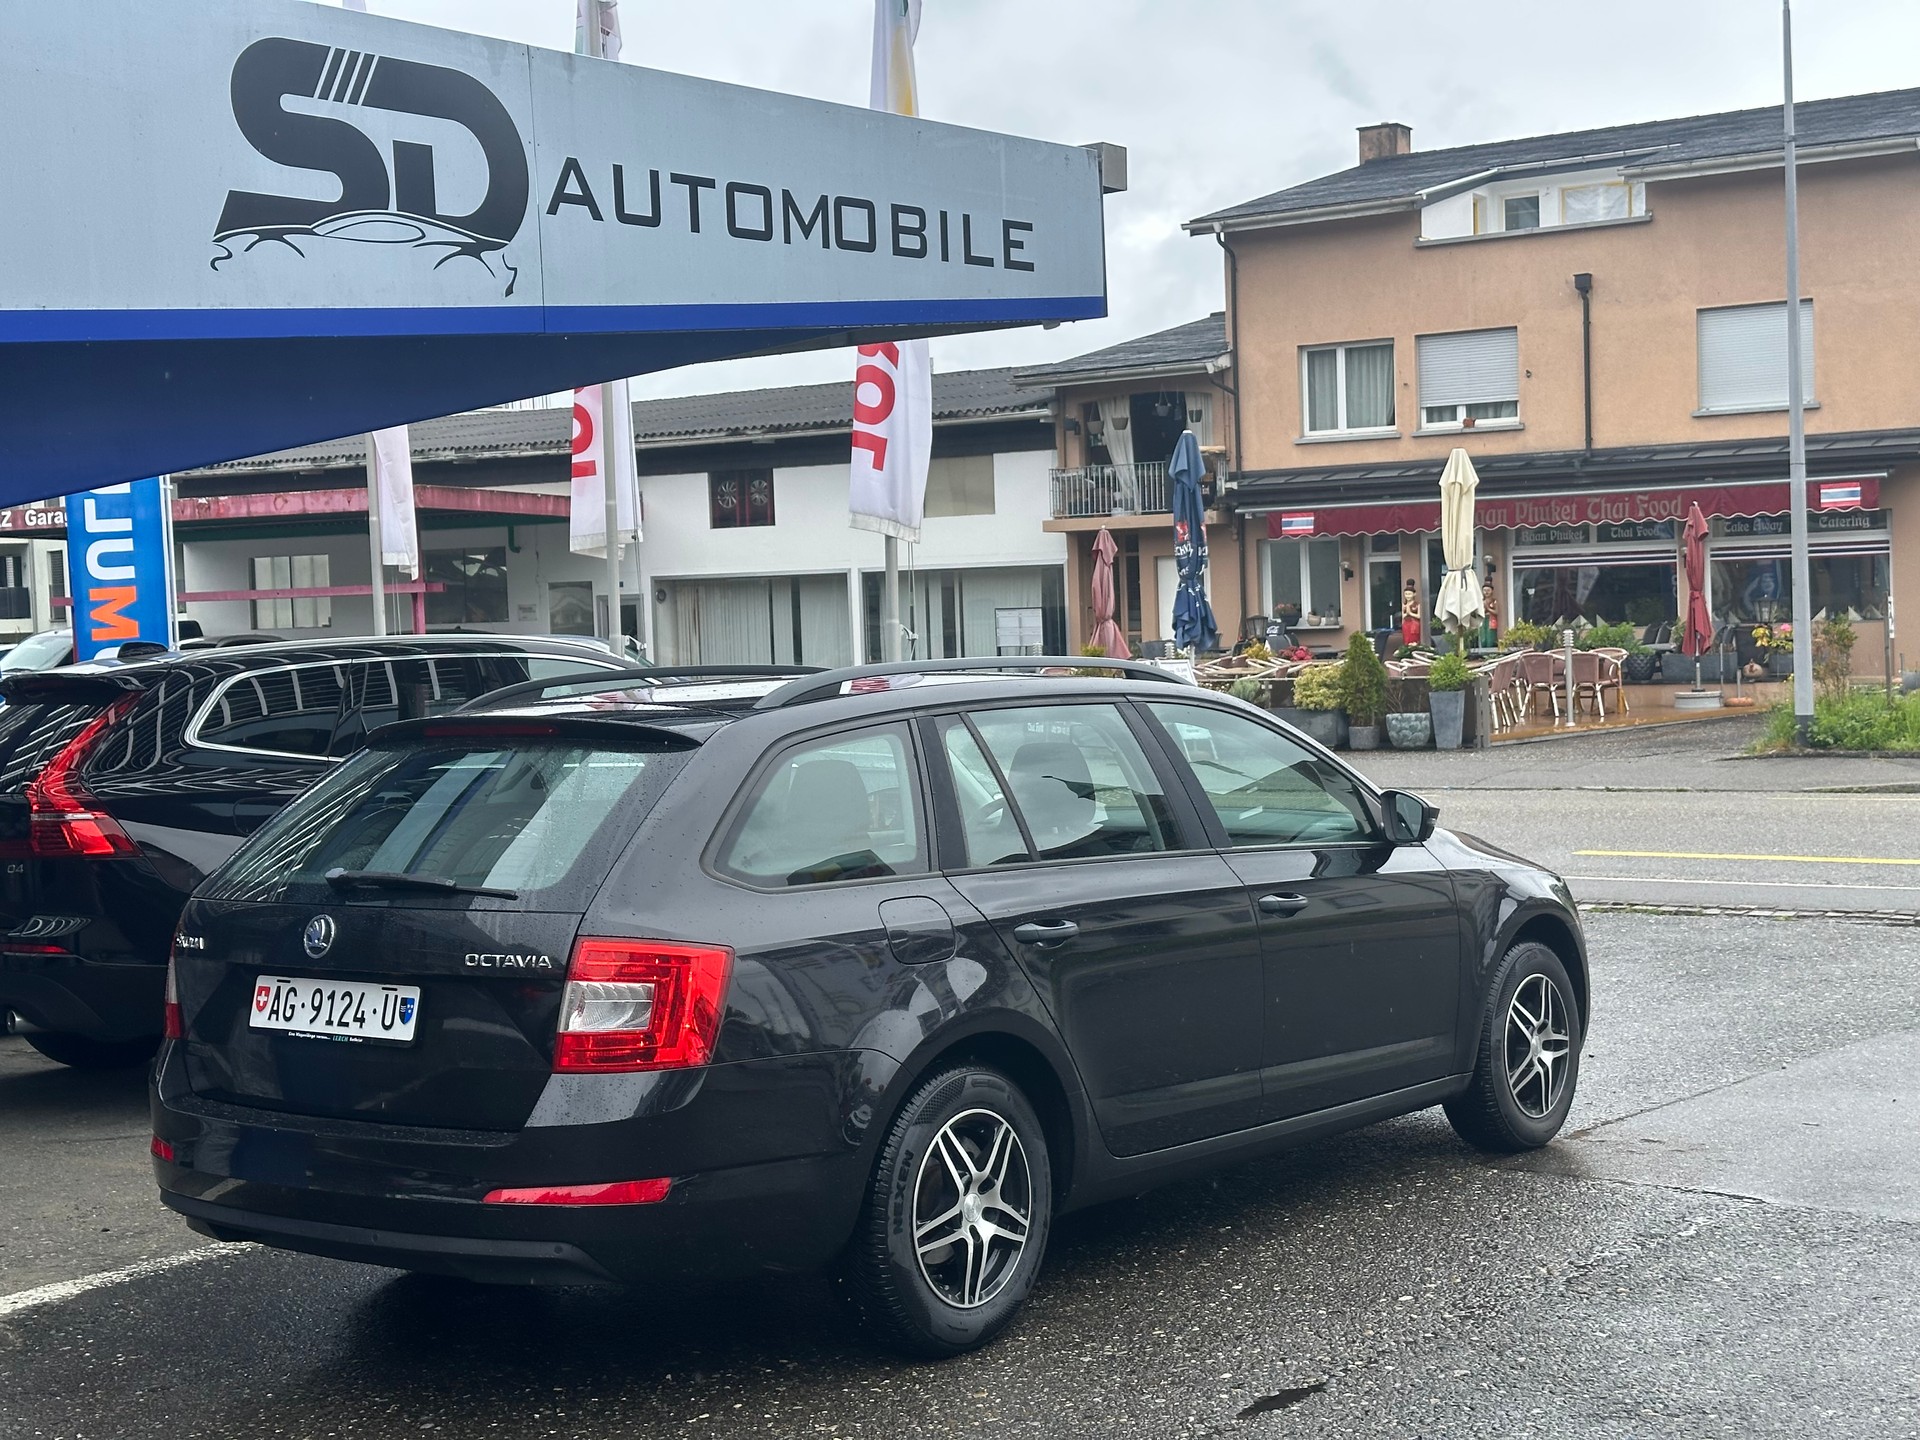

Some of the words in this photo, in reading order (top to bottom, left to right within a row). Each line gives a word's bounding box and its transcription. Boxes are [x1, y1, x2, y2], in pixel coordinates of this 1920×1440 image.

[213, 36, 530, 243] SD
[546, 156, 1035, 273] AUTOMOBILE
[1515, 500, 1577, 524] Phuket
[1587, 497, 1630, 520] Thai
[1637, 493, 1682, 518] Food
[0, 510, 13, 528] Z
[24, 509, 68, 528] Gara
[1818, 514, 1871, 529] Catering
[1636, 525, 1660, 537] Food
[1723, 521, 1750, 533] Take
[1550, 529, 1585, 541] Phuket
[464, 953, 552, 969] OCTAVIA
